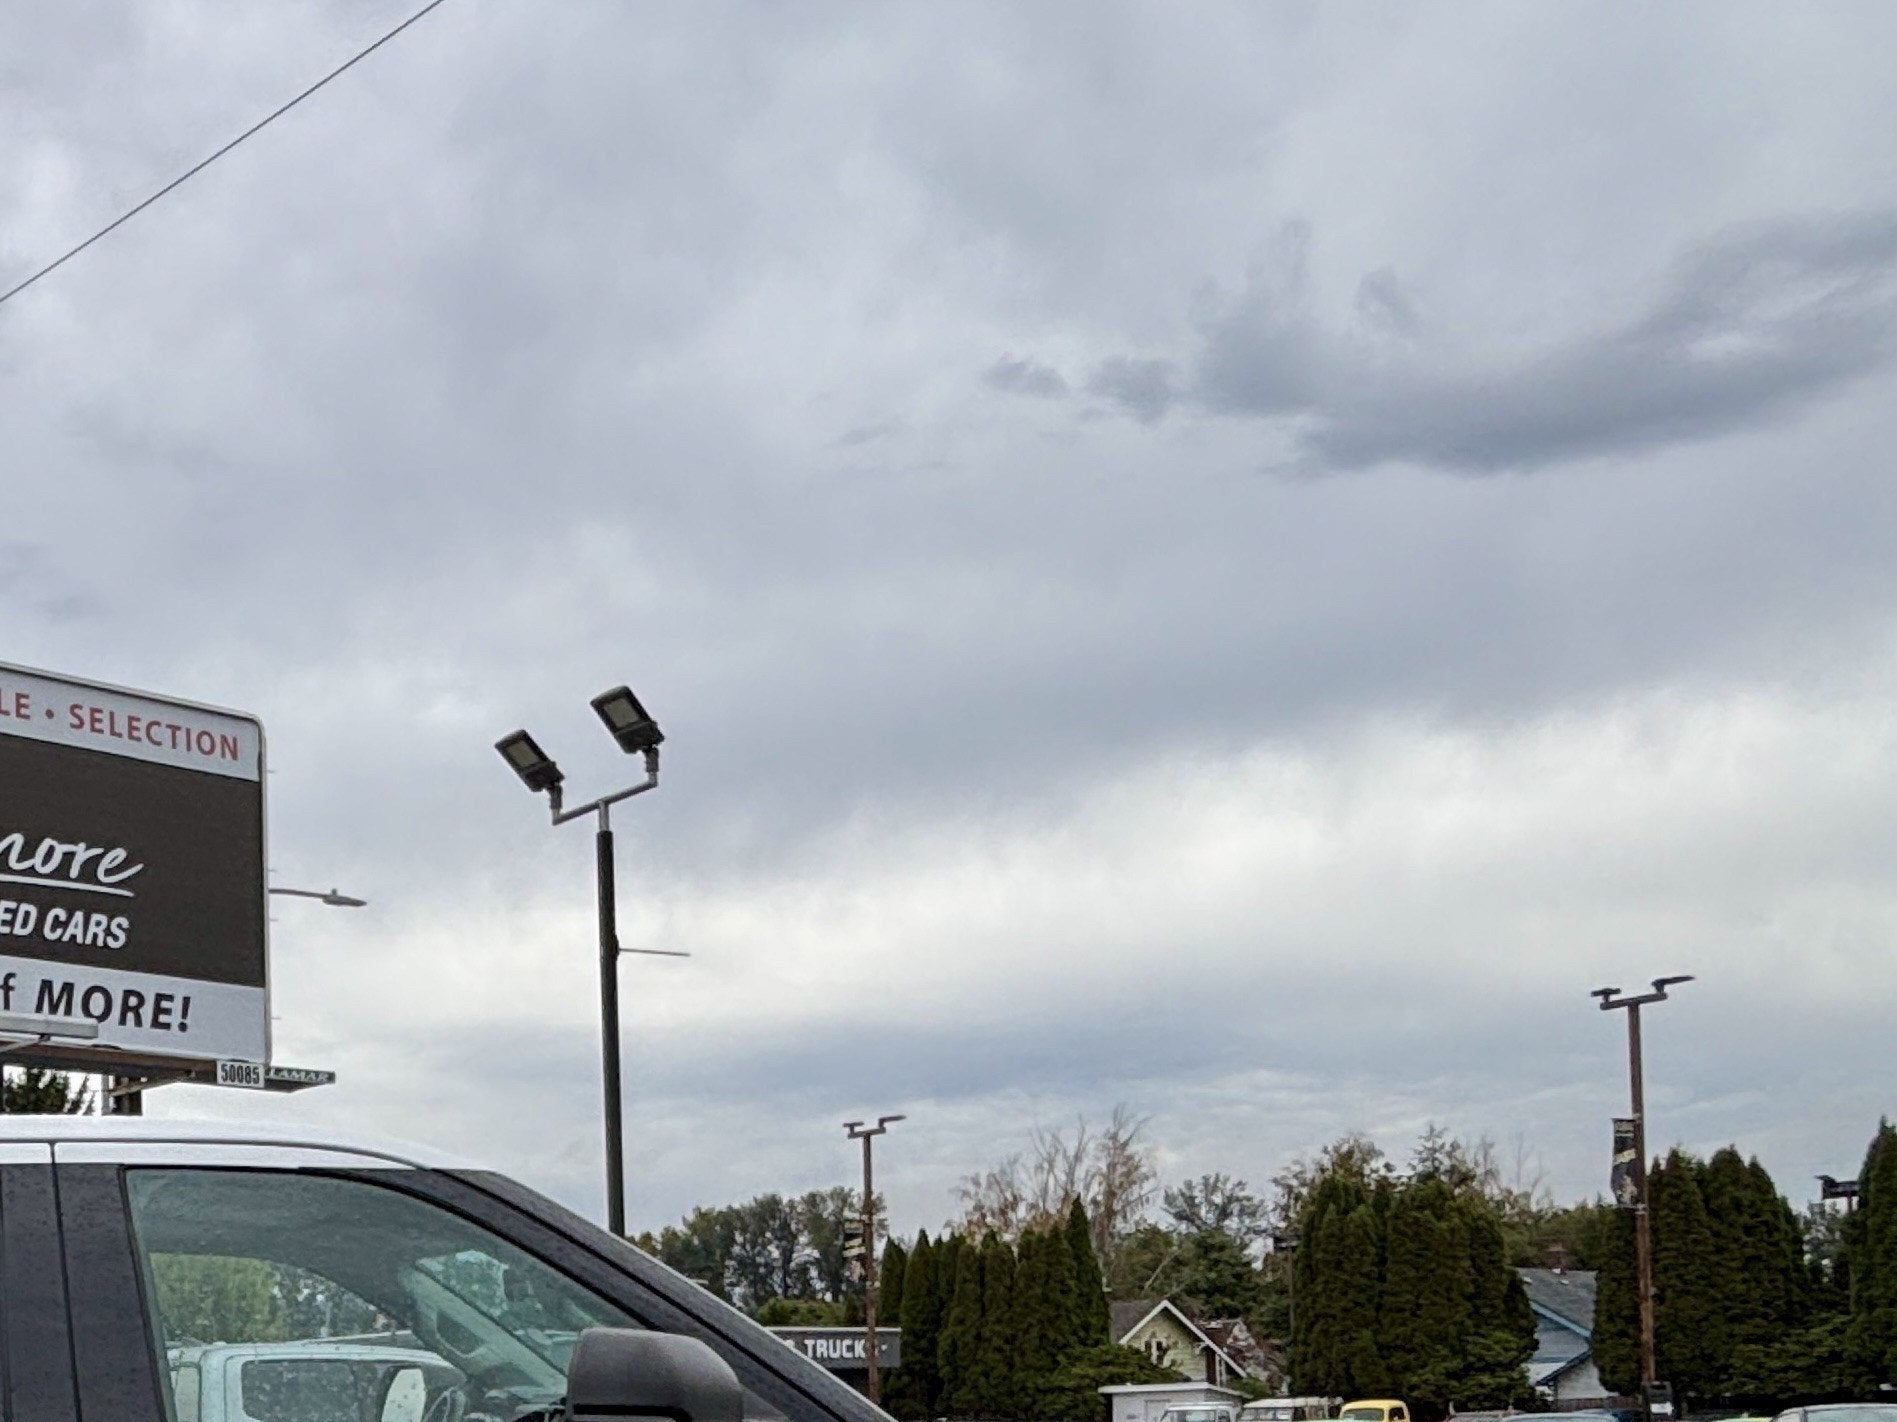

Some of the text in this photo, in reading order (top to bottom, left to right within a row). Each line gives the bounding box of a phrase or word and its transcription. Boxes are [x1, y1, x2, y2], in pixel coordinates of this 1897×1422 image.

[69, 703, 239, 761] SELECTION
[43, 907, 130, 949] CARS
[35, 979, 191, 1033] MORE!
